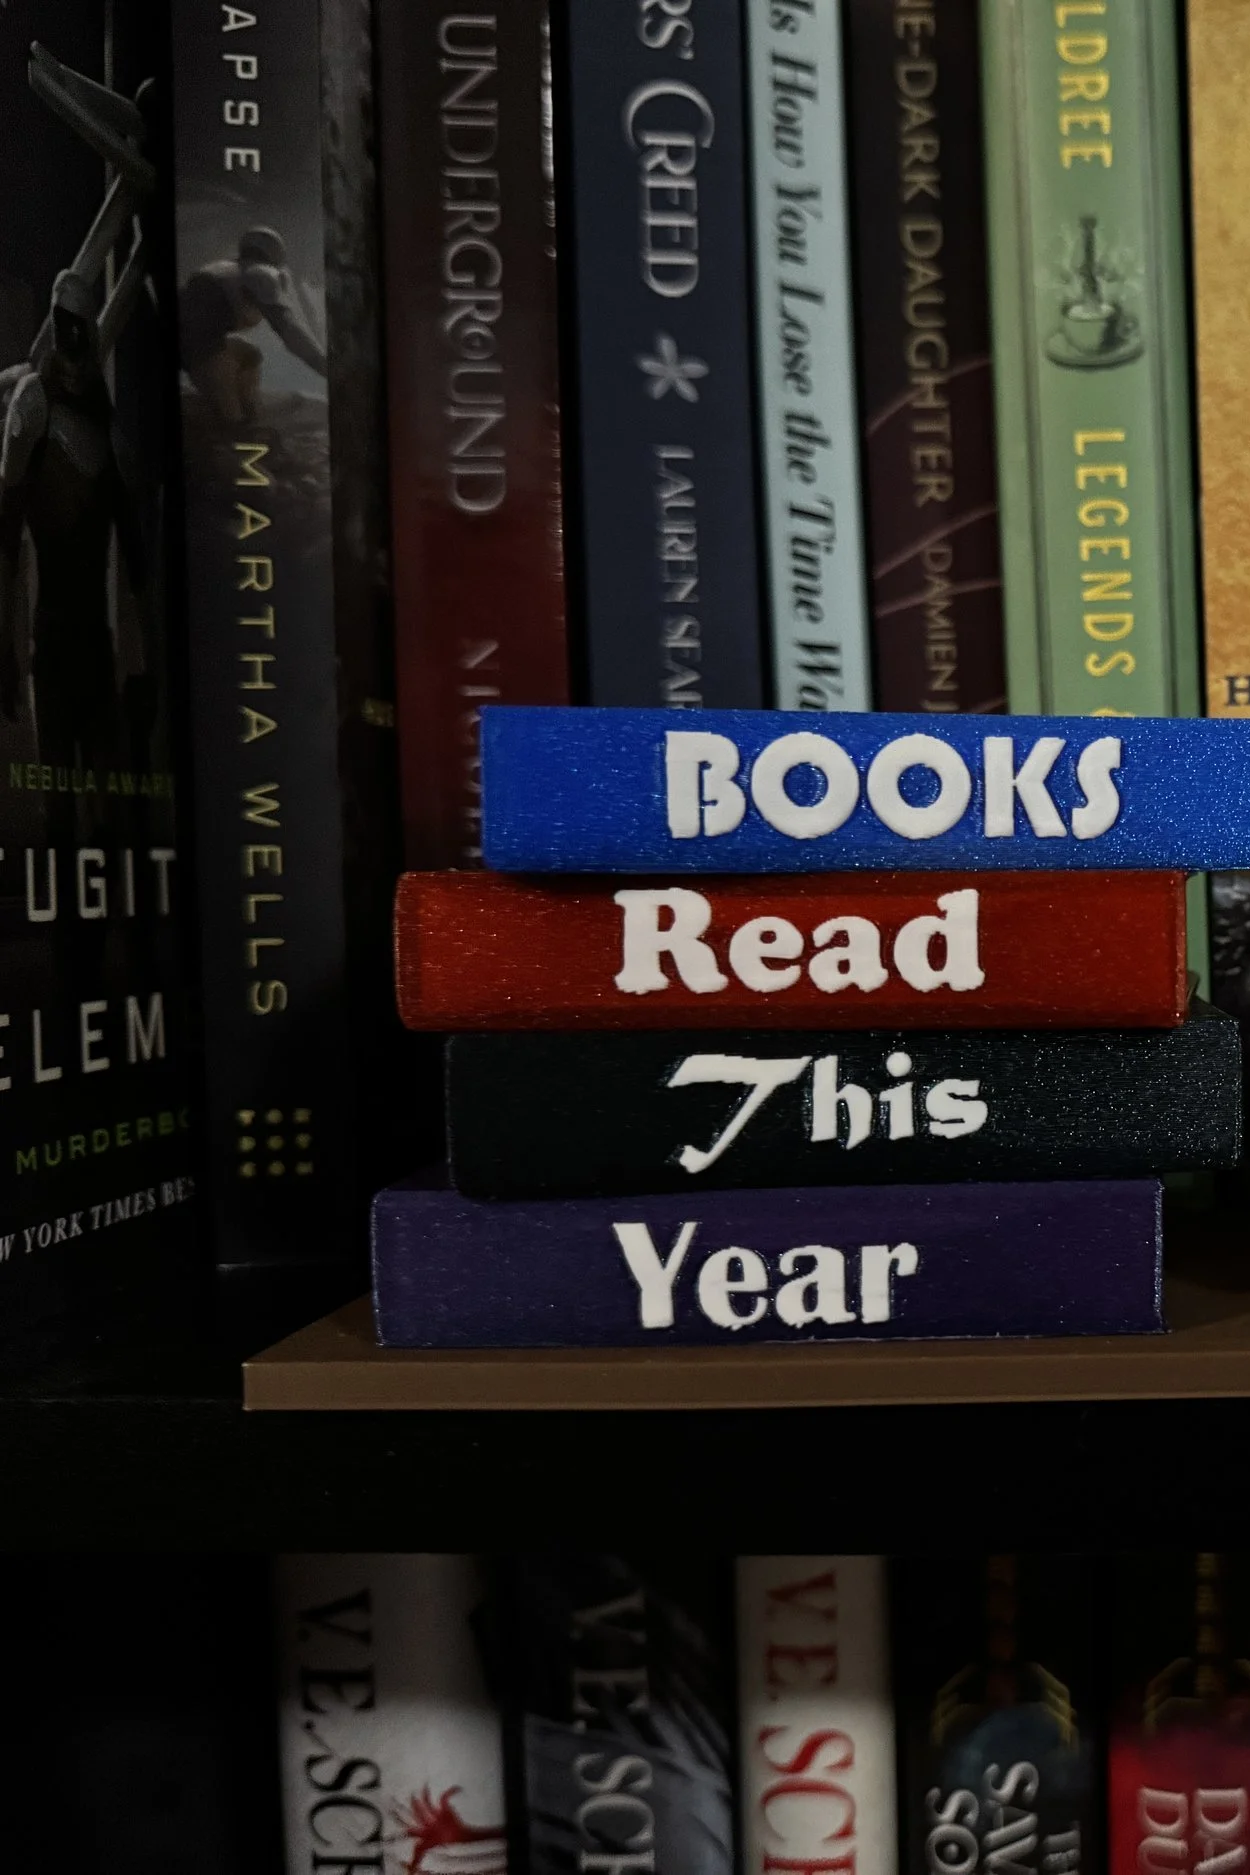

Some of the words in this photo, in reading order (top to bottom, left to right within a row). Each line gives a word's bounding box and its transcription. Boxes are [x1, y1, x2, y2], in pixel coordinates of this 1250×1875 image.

[771, 50, 817, 168] How
[893, 0, 942, 204] E-DARK
[621, 77, 716, 299] CREED
[774, 183, 822, 267] You
[437, 14, 508, 517] UNDERGROUND
[779, 278, 825, 396] Lose
[900, 213, 956, 507] DAUGHTER
[783, 408, 832, 485] the
[652, 443, 699, 604] LAUREN
[789, 493, 836, 624] Time
[1072, 428, 1137, 678] LEGENDS
[234, 442, 279, 744] MARTHA
[920, 541, 960, 693] DAMIEN
[8, 762, 98, 794] NEBULA
[664, 730, 1122, 840] BOOKS
[0, 847, 178, 922] UGIT
[240, 781, 290, 1016] WELLS
[612, 887, 985, 997] Read
[665, 1051, 990, 1175] This
[22, 1210, 85, 1254] YORK
[89, 1187, 157, 1231] TIMES
[611, 1220, 920, 1332] Year
